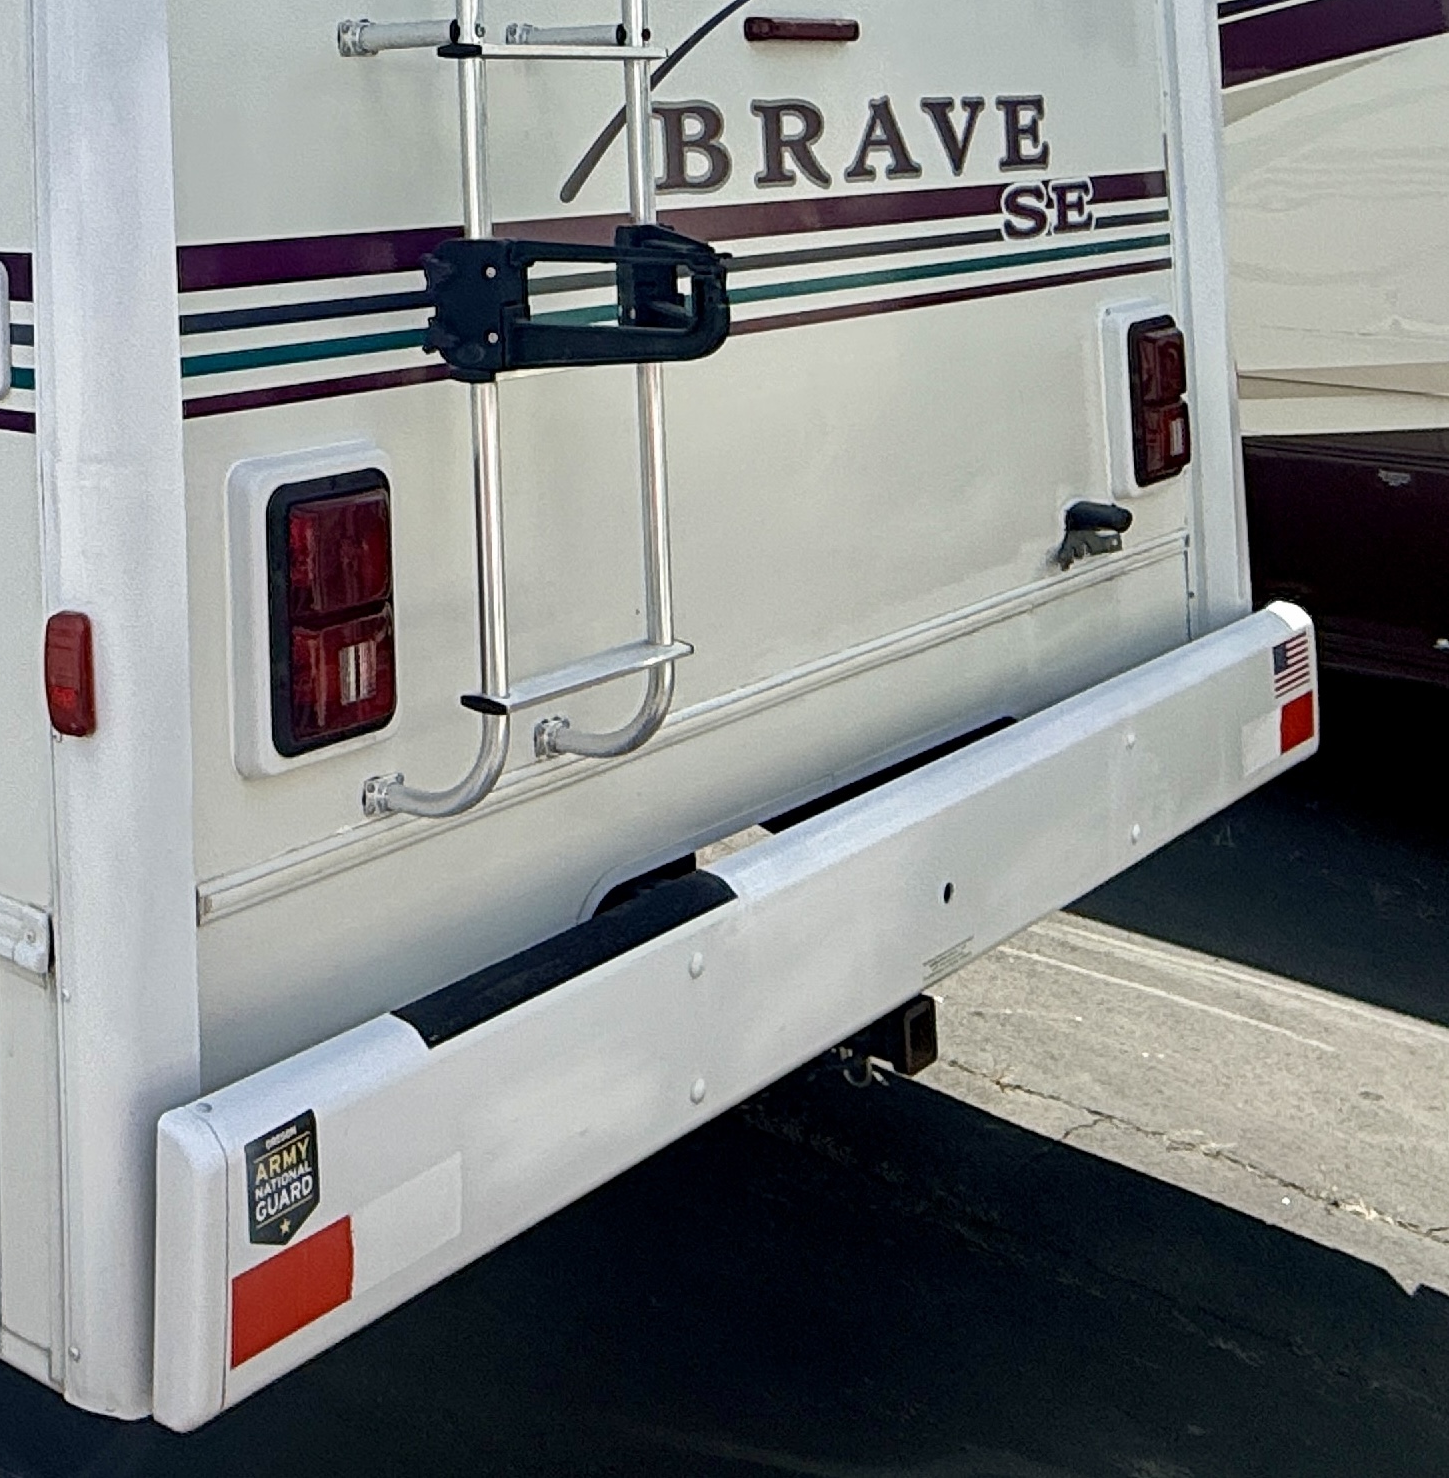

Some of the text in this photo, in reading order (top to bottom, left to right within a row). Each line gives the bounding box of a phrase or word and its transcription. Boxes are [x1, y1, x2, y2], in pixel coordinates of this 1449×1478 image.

[651, 95, 1050, 195] BRAVE
[1001, 178, 1094, 241] SE
[255, 1137, 310, 1185] ARMY
[255, 1160, 312, 1201] NATIONAL
[255, 1176, 313, 1221] GUARD
